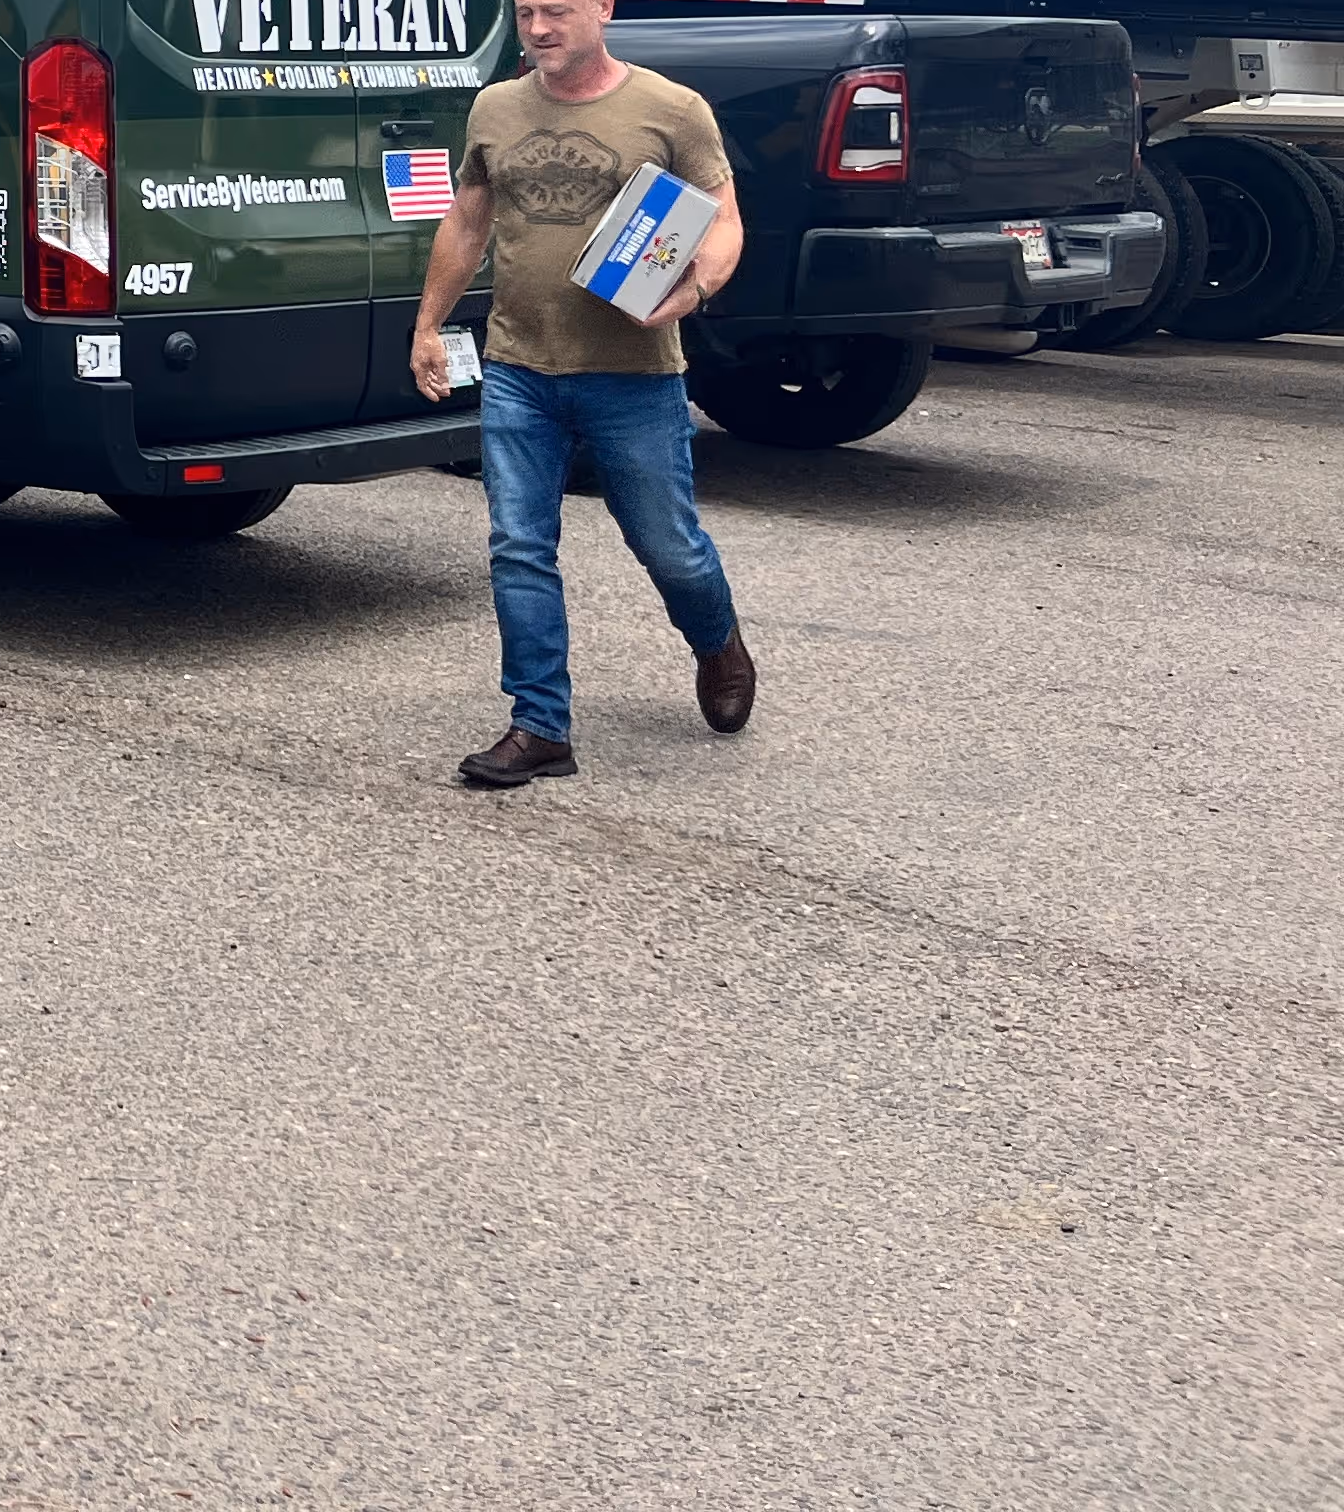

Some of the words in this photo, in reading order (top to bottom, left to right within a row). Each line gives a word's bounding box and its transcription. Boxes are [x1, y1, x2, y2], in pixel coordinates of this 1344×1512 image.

[193, 66, 263, 91] HEATING
[274, 65, 339, 90] COOLING
[351, 65, 418, 89] PLUMBING
[426, 65, 483, 89] ELECTRIC
[141, 173, 346, 212] ServiceByVeteran.com
[616, 215, 658, 266] ORIGINAL
[124, 263, 193, 295] 4957
